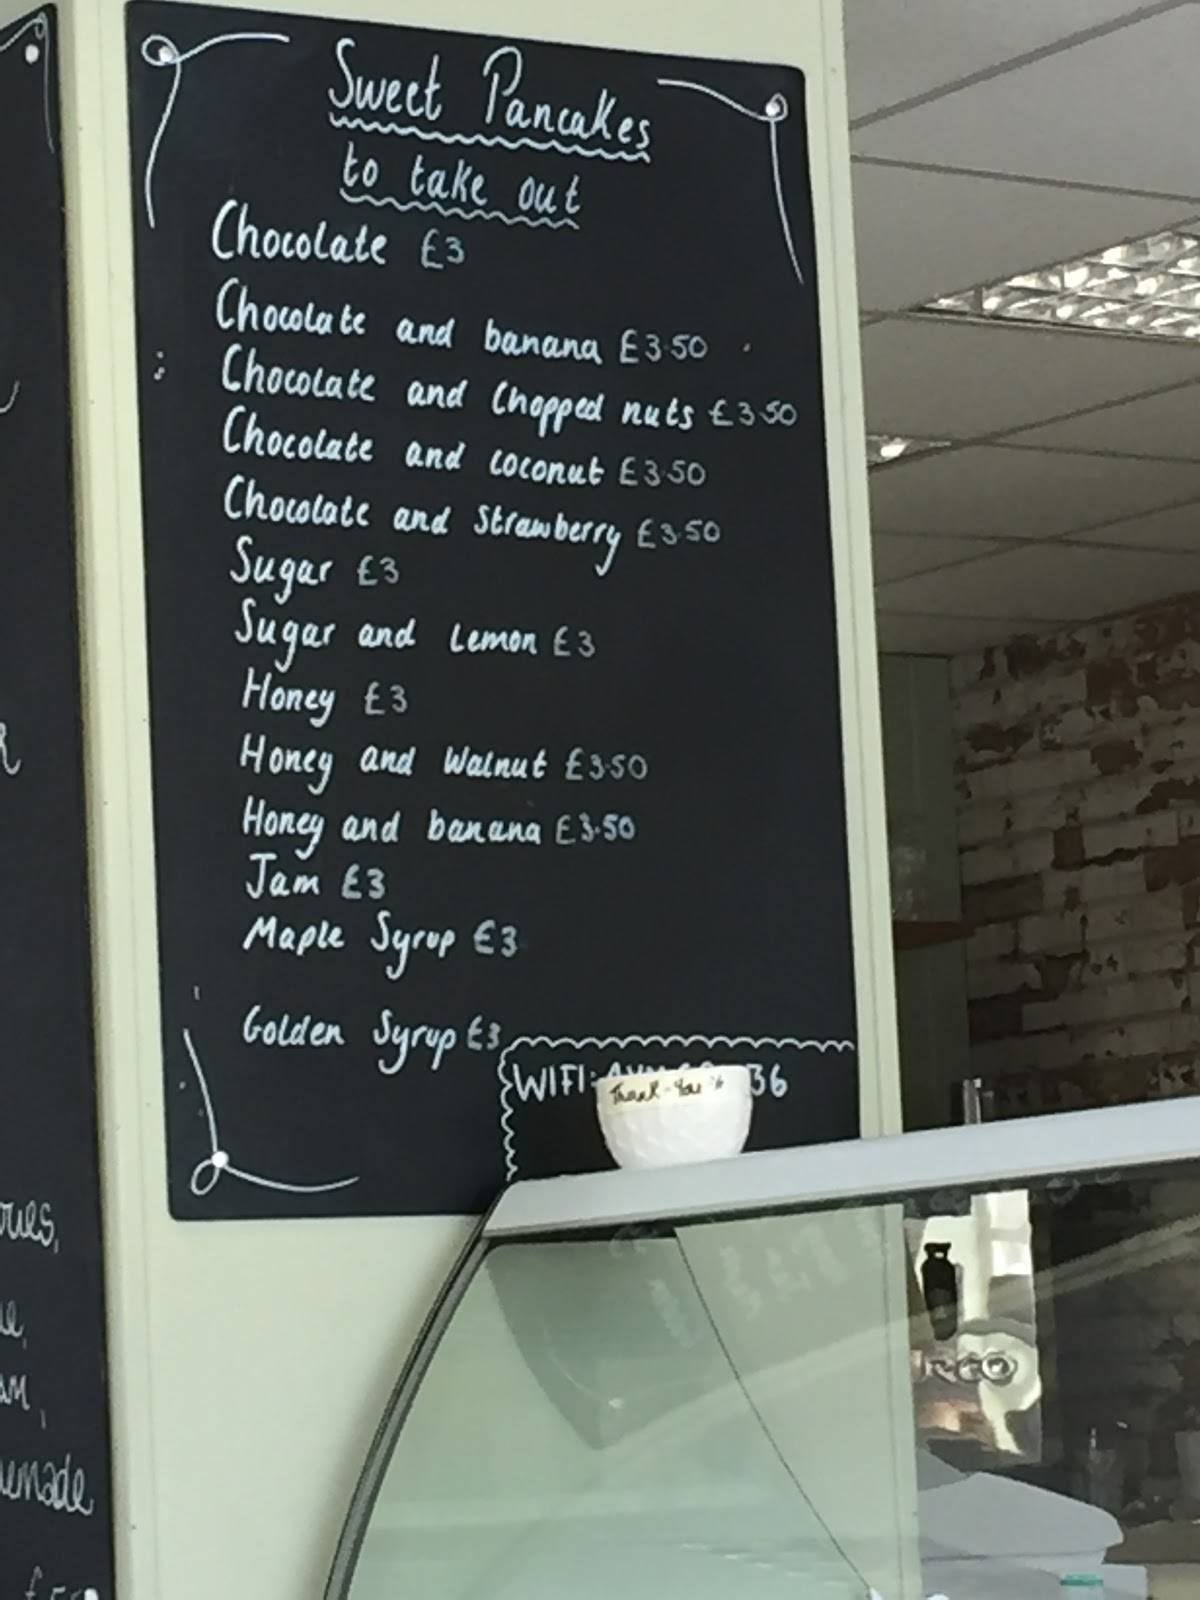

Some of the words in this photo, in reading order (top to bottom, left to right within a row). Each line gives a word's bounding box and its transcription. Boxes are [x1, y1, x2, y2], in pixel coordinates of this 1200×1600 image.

[328, 38, 442, 120] Sweet
[343, 141, 378, 187] to
[410, 159, 487, 205] take
[519, 175, 580, 214] out
[212, 199, 387, 264] Chocolate
[421, 229, 464, 268] £3
[216, 277, 365, 335] Chocolate
[396, 318, 455, 348] and
[485, 318, 602, 364] banana
[222, 343, 375, 401] Chocolate
[407, 380, 466, 408] and
[622, 398, 694, 430] nuts
[223, 405, 372, 462] Chocolate
[406, 441, 466, 470] and
[224, 474, 369, 527] Chocolate
[394, 506, 451, 534] and
[230, 535, 333, 605] Sugar
[357, 556, 398, 585] £3
[235, 599, 335, 673] Sugar
[358, 618, 416, 648] and
[554, 626, 595, 657] £3
[242, 667, 335, 727] Honey
[365, 682, 407, 714] £3
[240, 733, 333, 795] Honey
[360, 745, 414, 776] and
[243, 796, 324, 859] Honey
[342, 811, 400, 842] and
[427, 809, 541, 844] banana
[246, 853, 319, 899] Jam
[342, 864, 385, 899] £3
[243, 916, 344, 956] Maple
[371, 910, 455, 980] Syrup
[474, 920, 517, 957] £3
[243, 1005, 344, 1046] Golden
[373, 1009, 456, 1074] Syrup
[468, 1017, 500, 1051] £3
